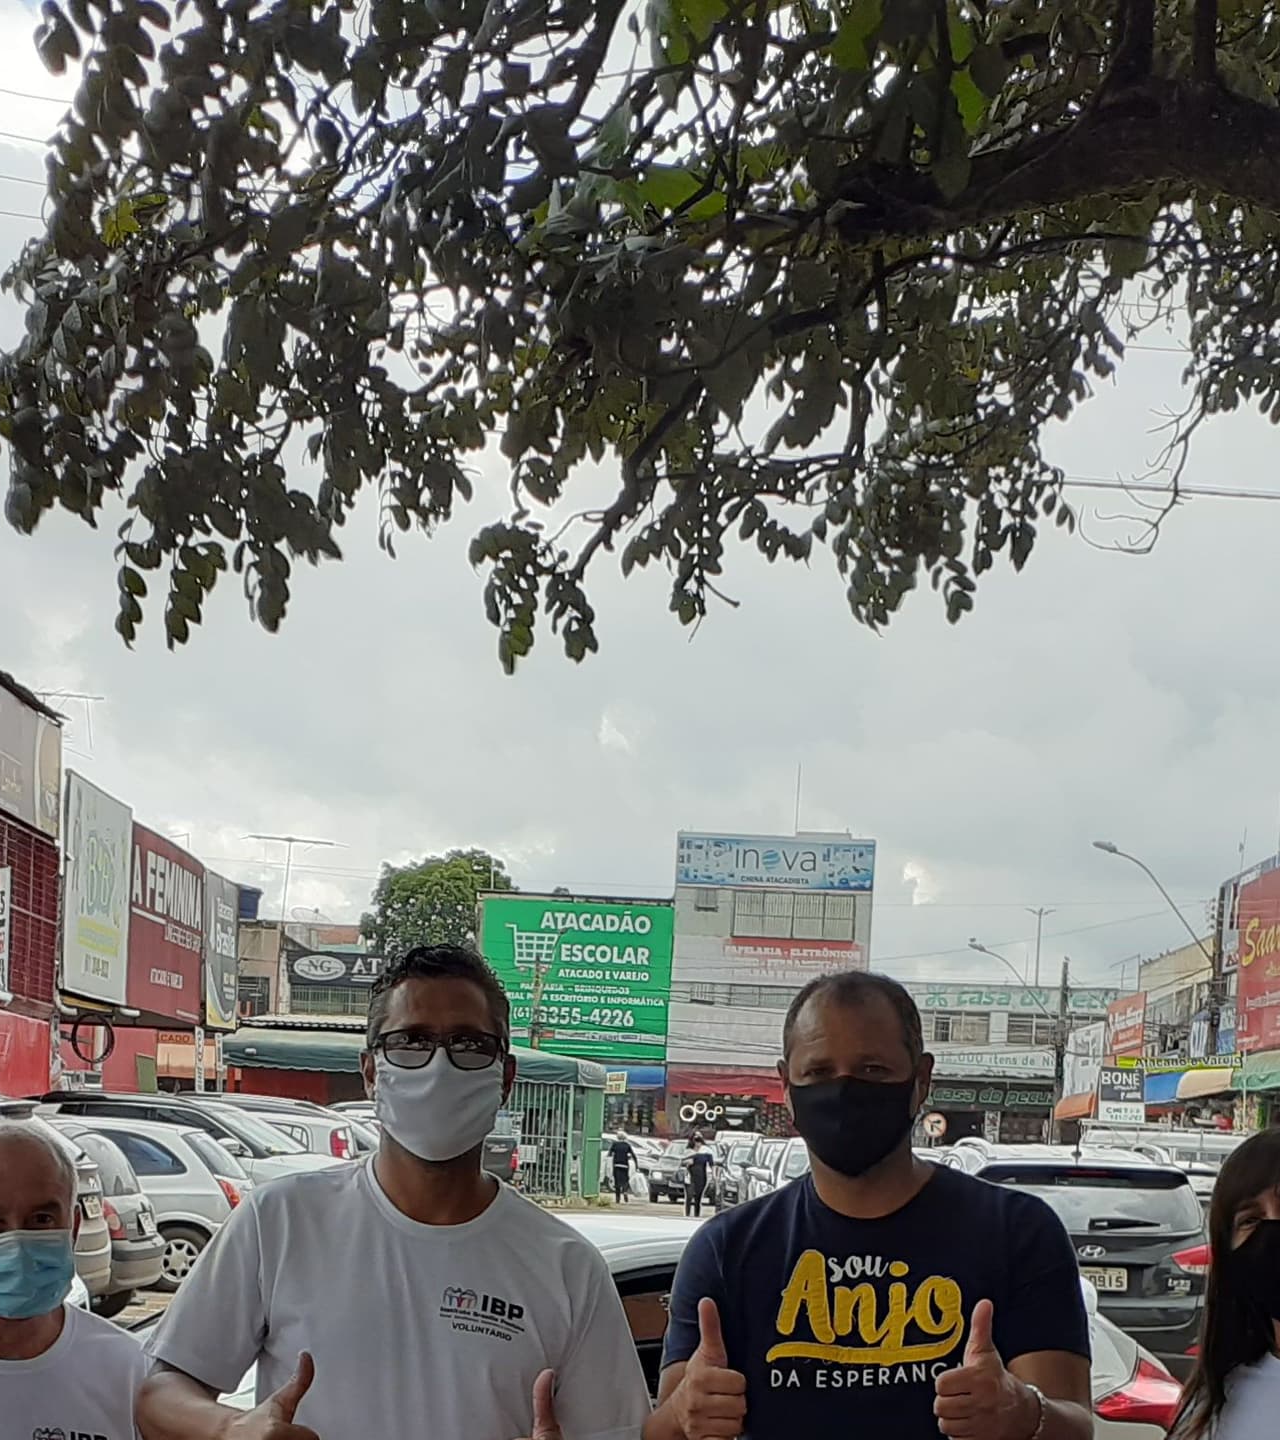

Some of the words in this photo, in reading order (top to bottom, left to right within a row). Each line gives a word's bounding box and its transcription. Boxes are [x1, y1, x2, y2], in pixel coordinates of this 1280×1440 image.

[147, 850, 202, 932] FEMININA
[540, 911, 652, 934] ATACADÃO
[560, 944, 650, 965] ESCOLAR
[308, 960, 332, 974] NG
[558, 968, 604, 980] ATACADO
[612, 971, 650, 982] VAREJO
[1021, 1054, 1036, 1067] de
[827, 1254, 890, 1283] sou
[481, 1294, 524, 1321] IBP
[770, 1249, 965, 1358] Anjo
[770, 1368, 801, 1388] DA
